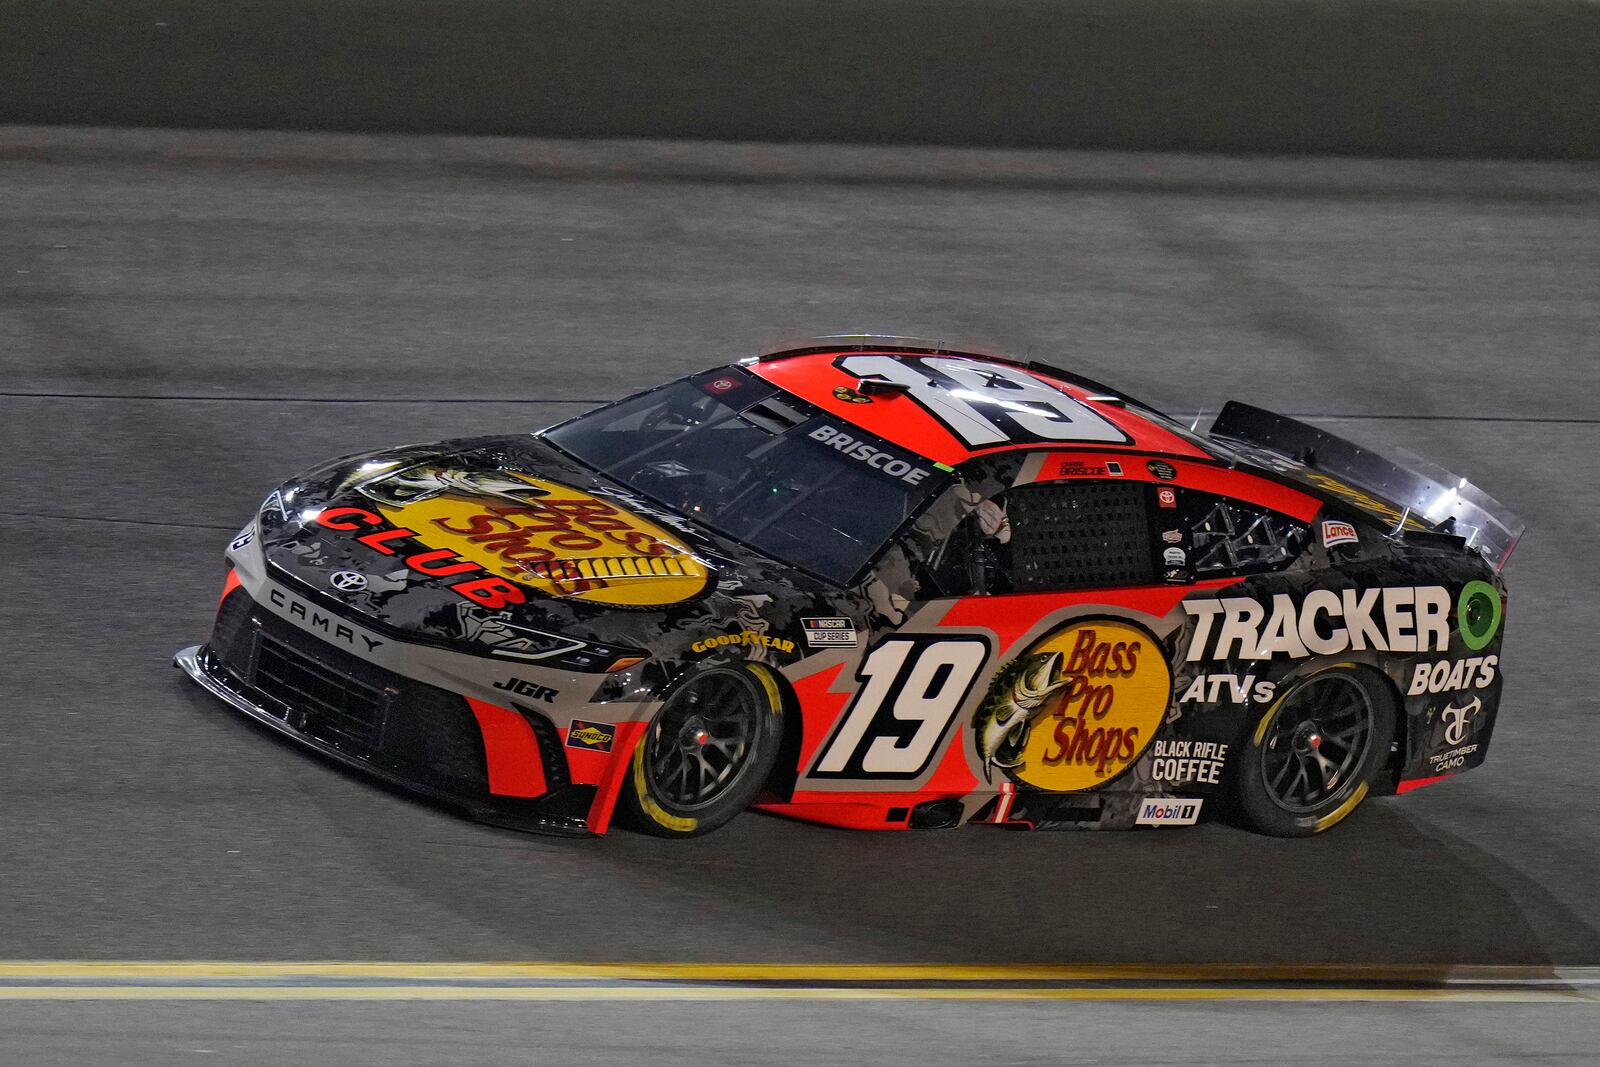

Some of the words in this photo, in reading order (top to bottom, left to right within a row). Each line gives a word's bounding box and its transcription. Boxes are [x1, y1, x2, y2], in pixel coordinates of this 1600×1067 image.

[836, 354, 1128, 446] 19
[808, 425, 931, 486] BRISCOE
[1060, 467, 1106, 476] BRISCOE
[485, 506, 603, 551] Pro
[533, 499, 673, 556] Bass
[1324, 523, 1355, 539] Lance
[314, 507, 527, 609] CLUB
[271, 589, 384, 652] CAMRY
[817, 619, 846, 629] NASCAR
[1182, 586, 1451, 662] TRACKER
[691, 630, 795, 654] GOODYEAR
[813, 632, 826, 641] CUP
[827, 632, 850, 641] SERIES
[1062, 629, 1142, 678] Bass
[493, 677, 560, 703] JGR
[1179, 674, 1277, 704] ATVs
[1407, 654, 1498, 696] BOATS
[815, 639, 987, 774] 19
[1052, 675, 1115, 720] Pro
[572, 729, 612, 742] SUNOCO
[1041, 716, 1139, 775] Shops
[1154, 740, 1192, 758] BLACK
[1193, 741, 1229, 761] RIFLE
[1429, 744, 1479, 765] TRUETIMBER
[1435, 756, 1465, 772] CAMO
[1152, 758, 1225, 785] COFFEE
[1142, 804, 1181, 819] Mobil
